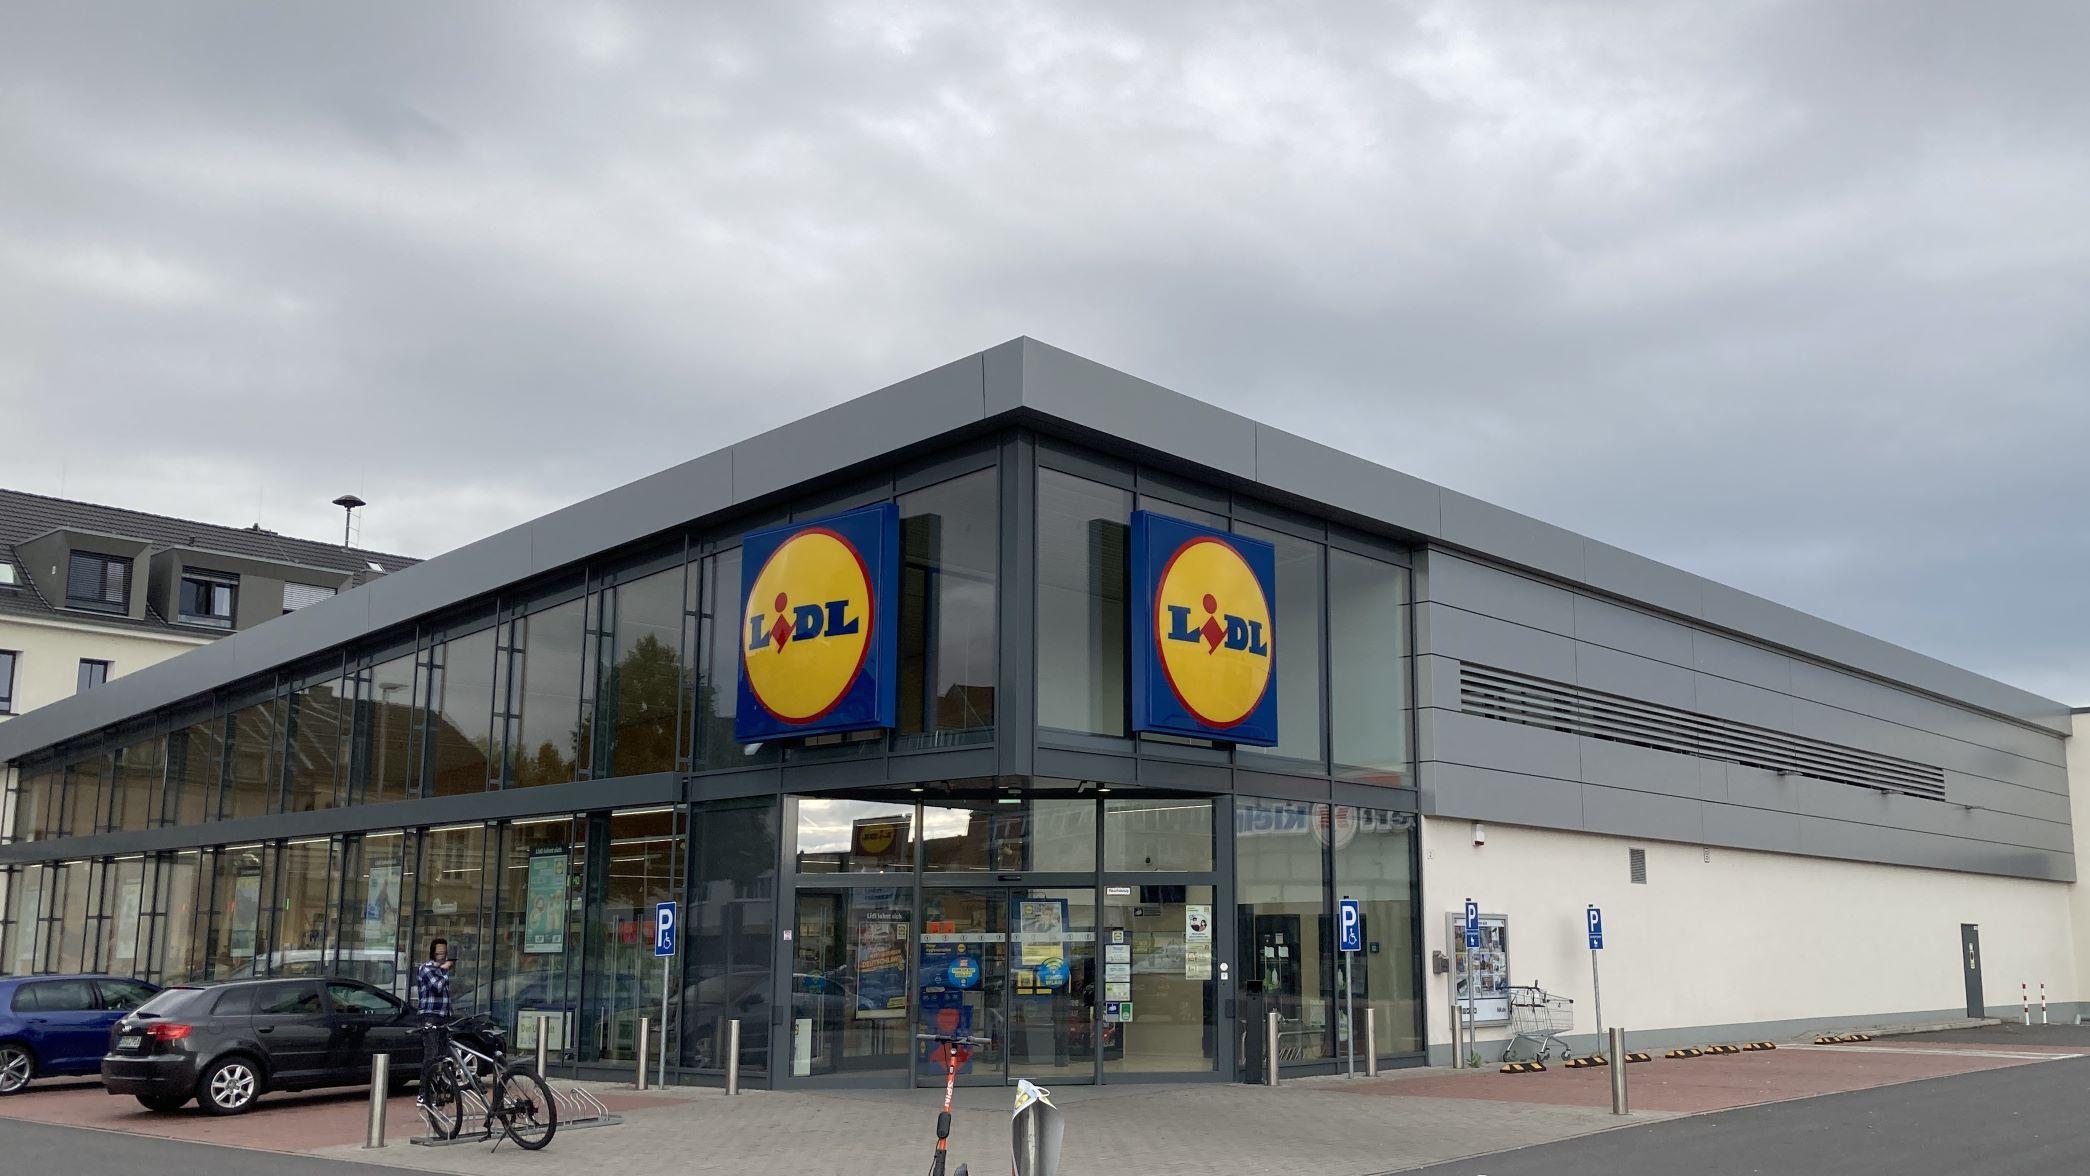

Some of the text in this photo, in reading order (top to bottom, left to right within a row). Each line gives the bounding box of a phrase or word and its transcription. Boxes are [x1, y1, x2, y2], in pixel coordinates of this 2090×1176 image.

[657, 909, 673, 947] P
[1342, 905, 1357, 942] P
[1468, 904, 1476, 928] P
[1590, 910, 1599, 931] P
